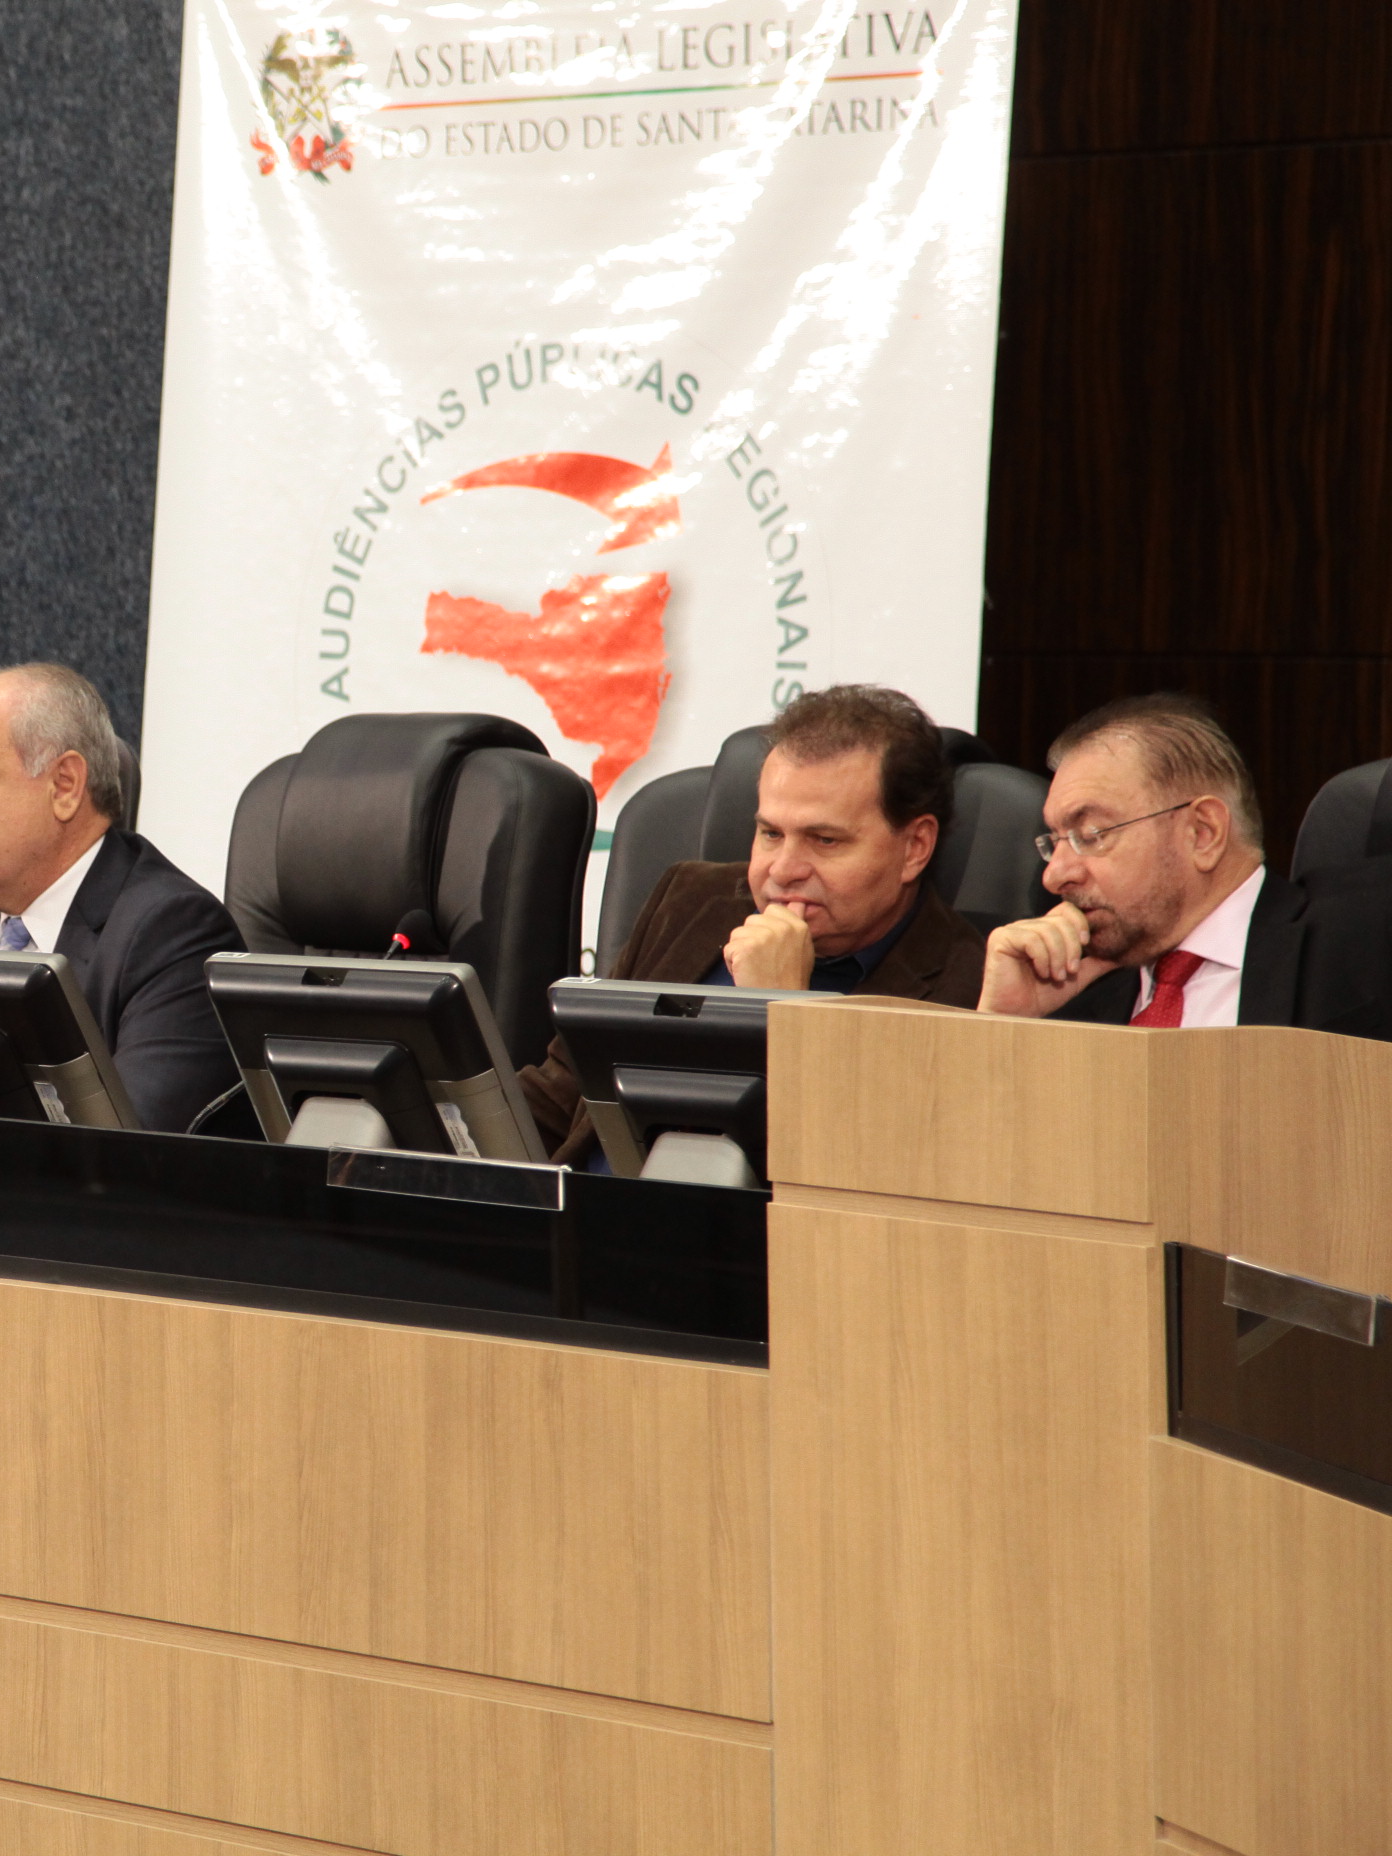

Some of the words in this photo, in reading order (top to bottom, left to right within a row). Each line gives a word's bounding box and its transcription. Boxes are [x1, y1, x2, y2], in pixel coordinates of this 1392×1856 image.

[657, 8, 939, 72] LEGISLTIVA
[444, 116, 571, 157] ESTADO
[583, 113, 623, 150] DE
[636, 106, 750, 148] SANT
[768, 96, 940, 138] TARINA
[320, 388, 467, 704] AUDIÊNCIAS
[704, 422, 810, 711] EGIONAIS
